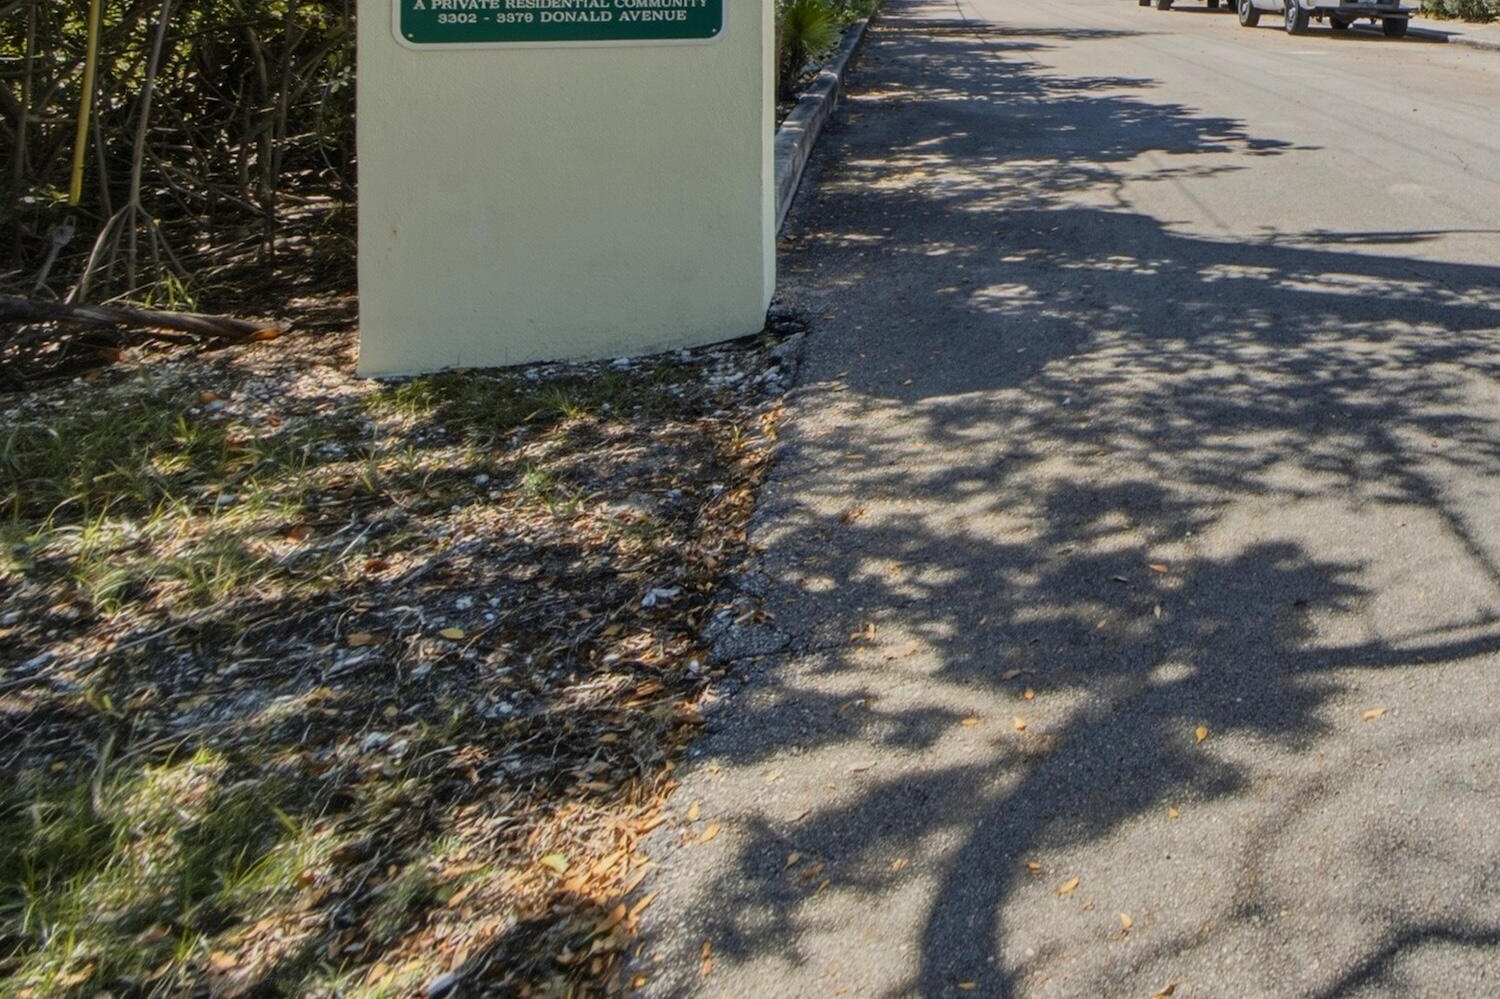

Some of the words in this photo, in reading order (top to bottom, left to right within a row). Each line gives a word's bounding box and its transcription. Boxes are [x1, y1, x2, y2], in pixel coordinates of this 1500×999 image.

[413, 0, 426, 10] A
[438, 13, 477, 24] 3302
[540, 11, 612, 23] DONALD
[619, 10, 687, 22] AVENUE
